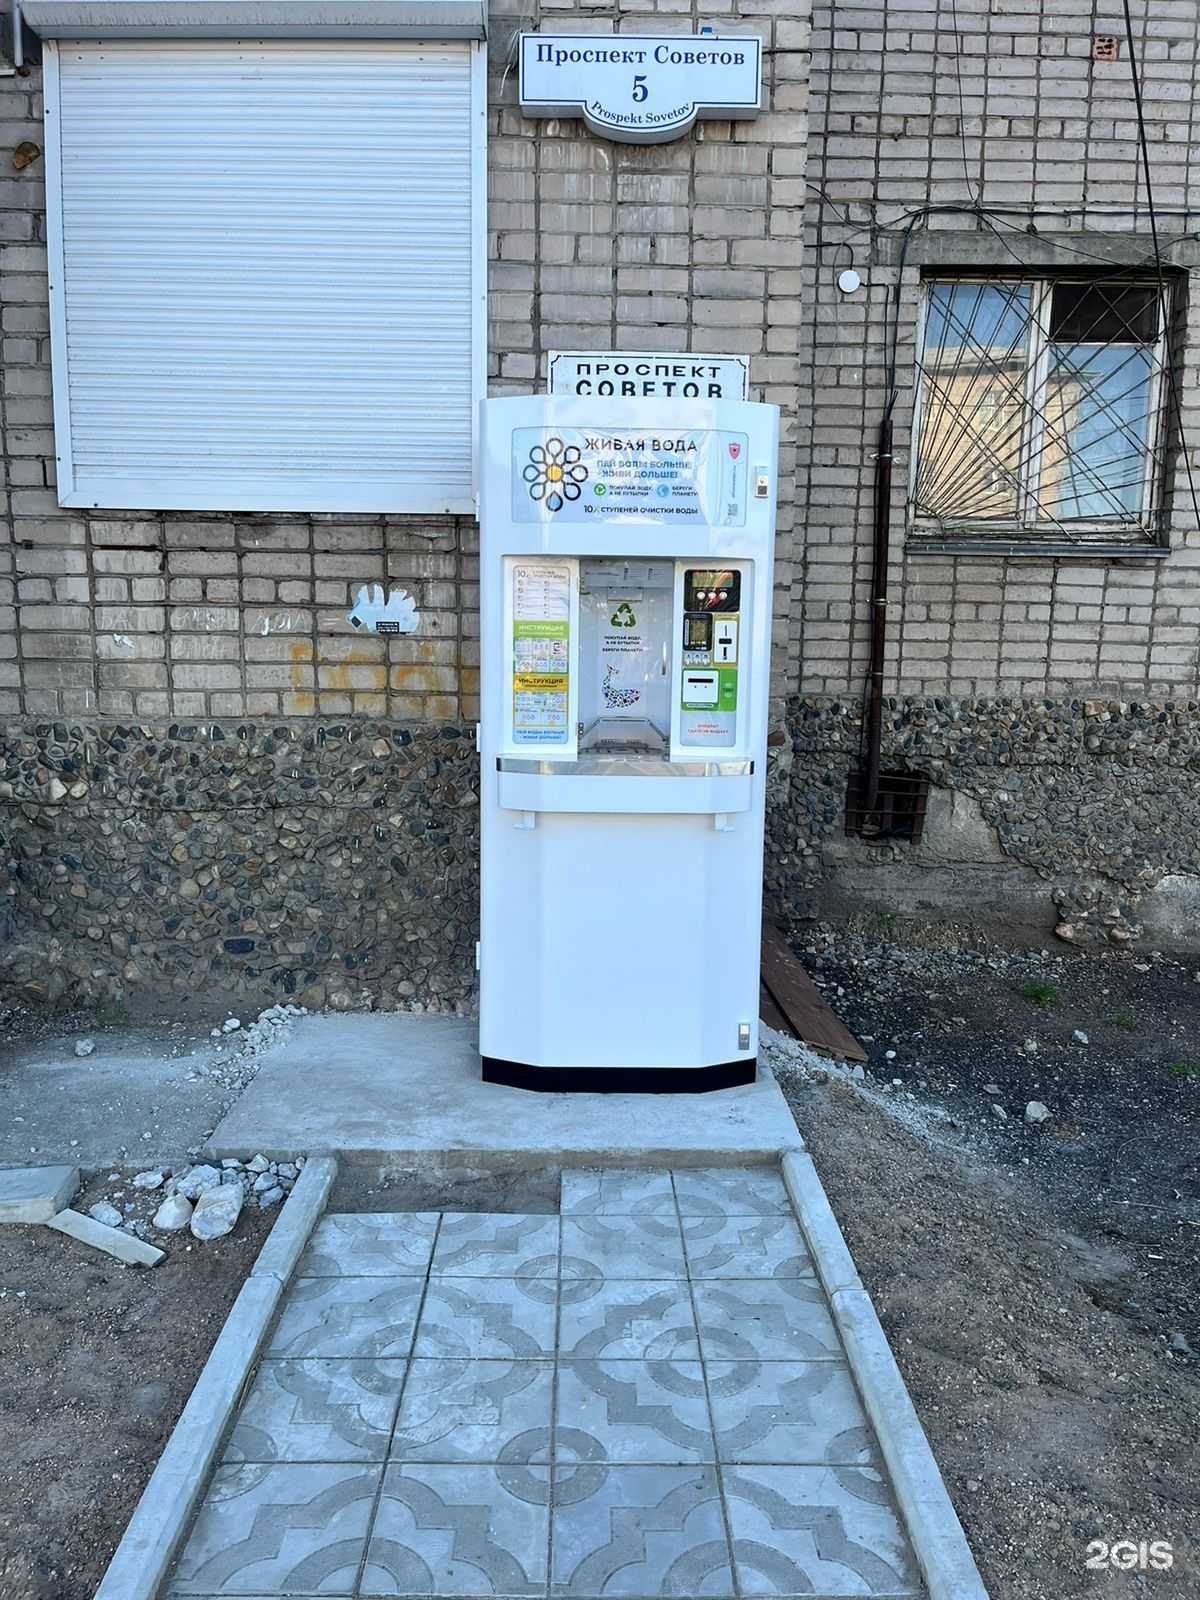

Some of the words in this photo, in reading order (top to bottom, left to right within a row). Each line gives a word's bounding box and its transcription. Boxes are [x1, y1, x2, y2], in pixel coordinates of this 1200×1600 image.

[536, 44, 647, 66] Проспект
[654, 45, 745, 65] Советов
[632, 75, 649, 103] 5
[592, 100, 642, 124] Prospekt
[645, 103, 691, 124] Sovetov
[576, 363, 721, 378] ПРОСПЕКТ
[585, 438, 645, 452] ЖИВАЯ
[652, 439, 698, 453] ВОДА
[600, 505, 639, 514] СТУПЕНЕЙ
[640, 506, 675, 514] ОЧИСТКИ
[676, 507, 698, 515] ВОДЫ
